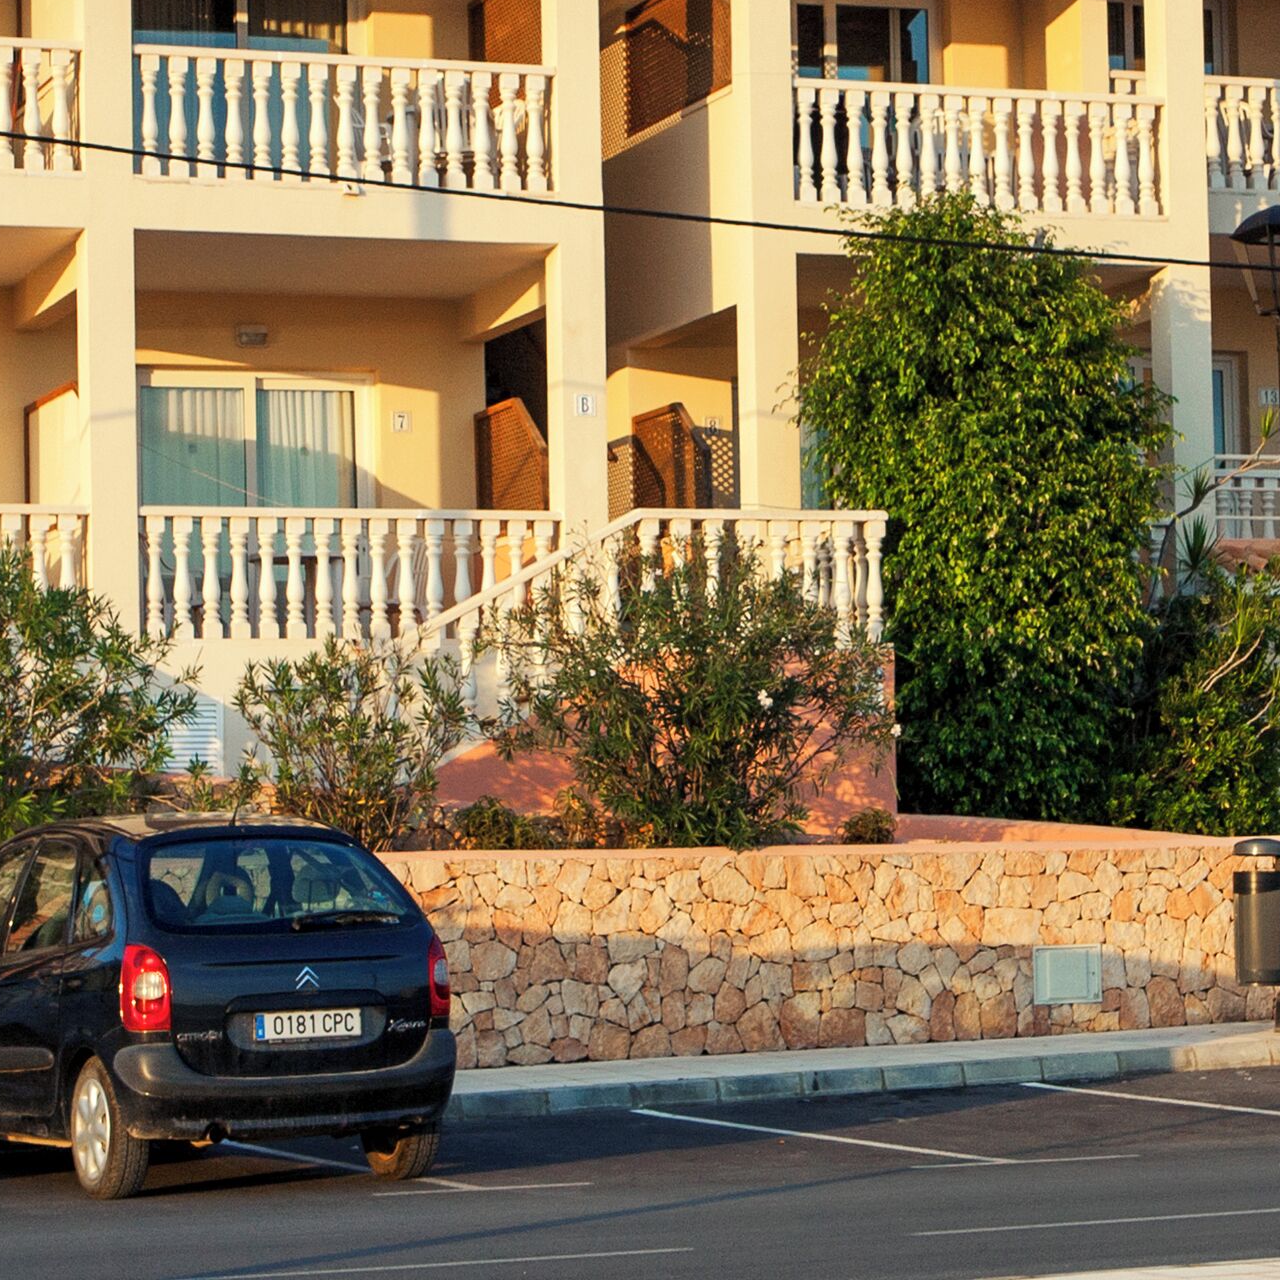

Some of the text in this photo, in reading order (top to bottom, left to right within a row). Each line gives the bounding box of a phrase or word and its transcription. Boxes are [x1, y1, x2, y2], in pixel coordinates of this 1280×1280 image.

[581, 396, 590, 413] B
[397, 414, 406, 429] 7
[273, 1012, 354, 1035] 0181 CPC
